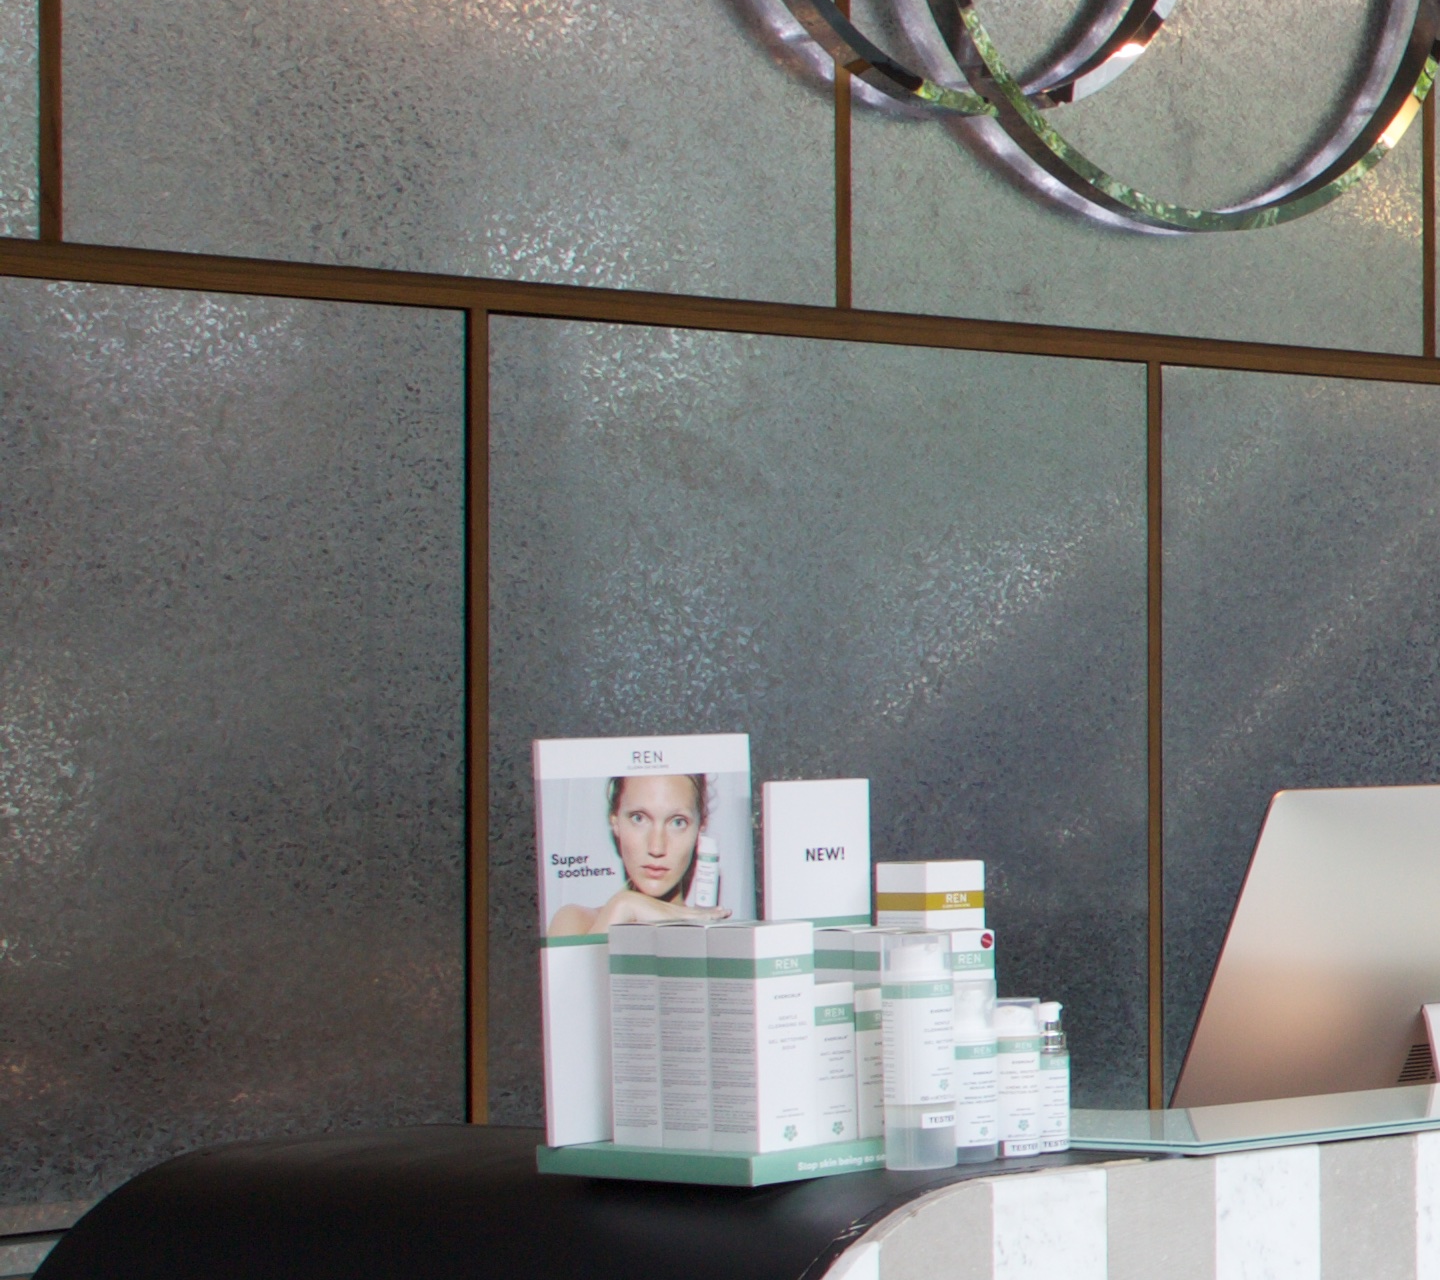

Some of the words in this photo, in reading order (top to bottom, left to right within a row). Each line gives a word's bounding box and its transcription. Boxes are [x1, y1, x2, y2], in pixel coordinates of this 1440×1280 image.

[632, 750, 664, 764] REN
[551, 853, 589, 867] Super
[805, 847, 845, 861] NEW!
[558, 866, 616, 879] soothers.
[945, 893, 968, 903] REN
[775, 959, 799, 970] REN
[957, 953, 981, 964] REN
[824, 1008, 846, 1018] REN
[798, 1161, 818, 1171] Stop
[819, 1158, 838, 1168] skin
